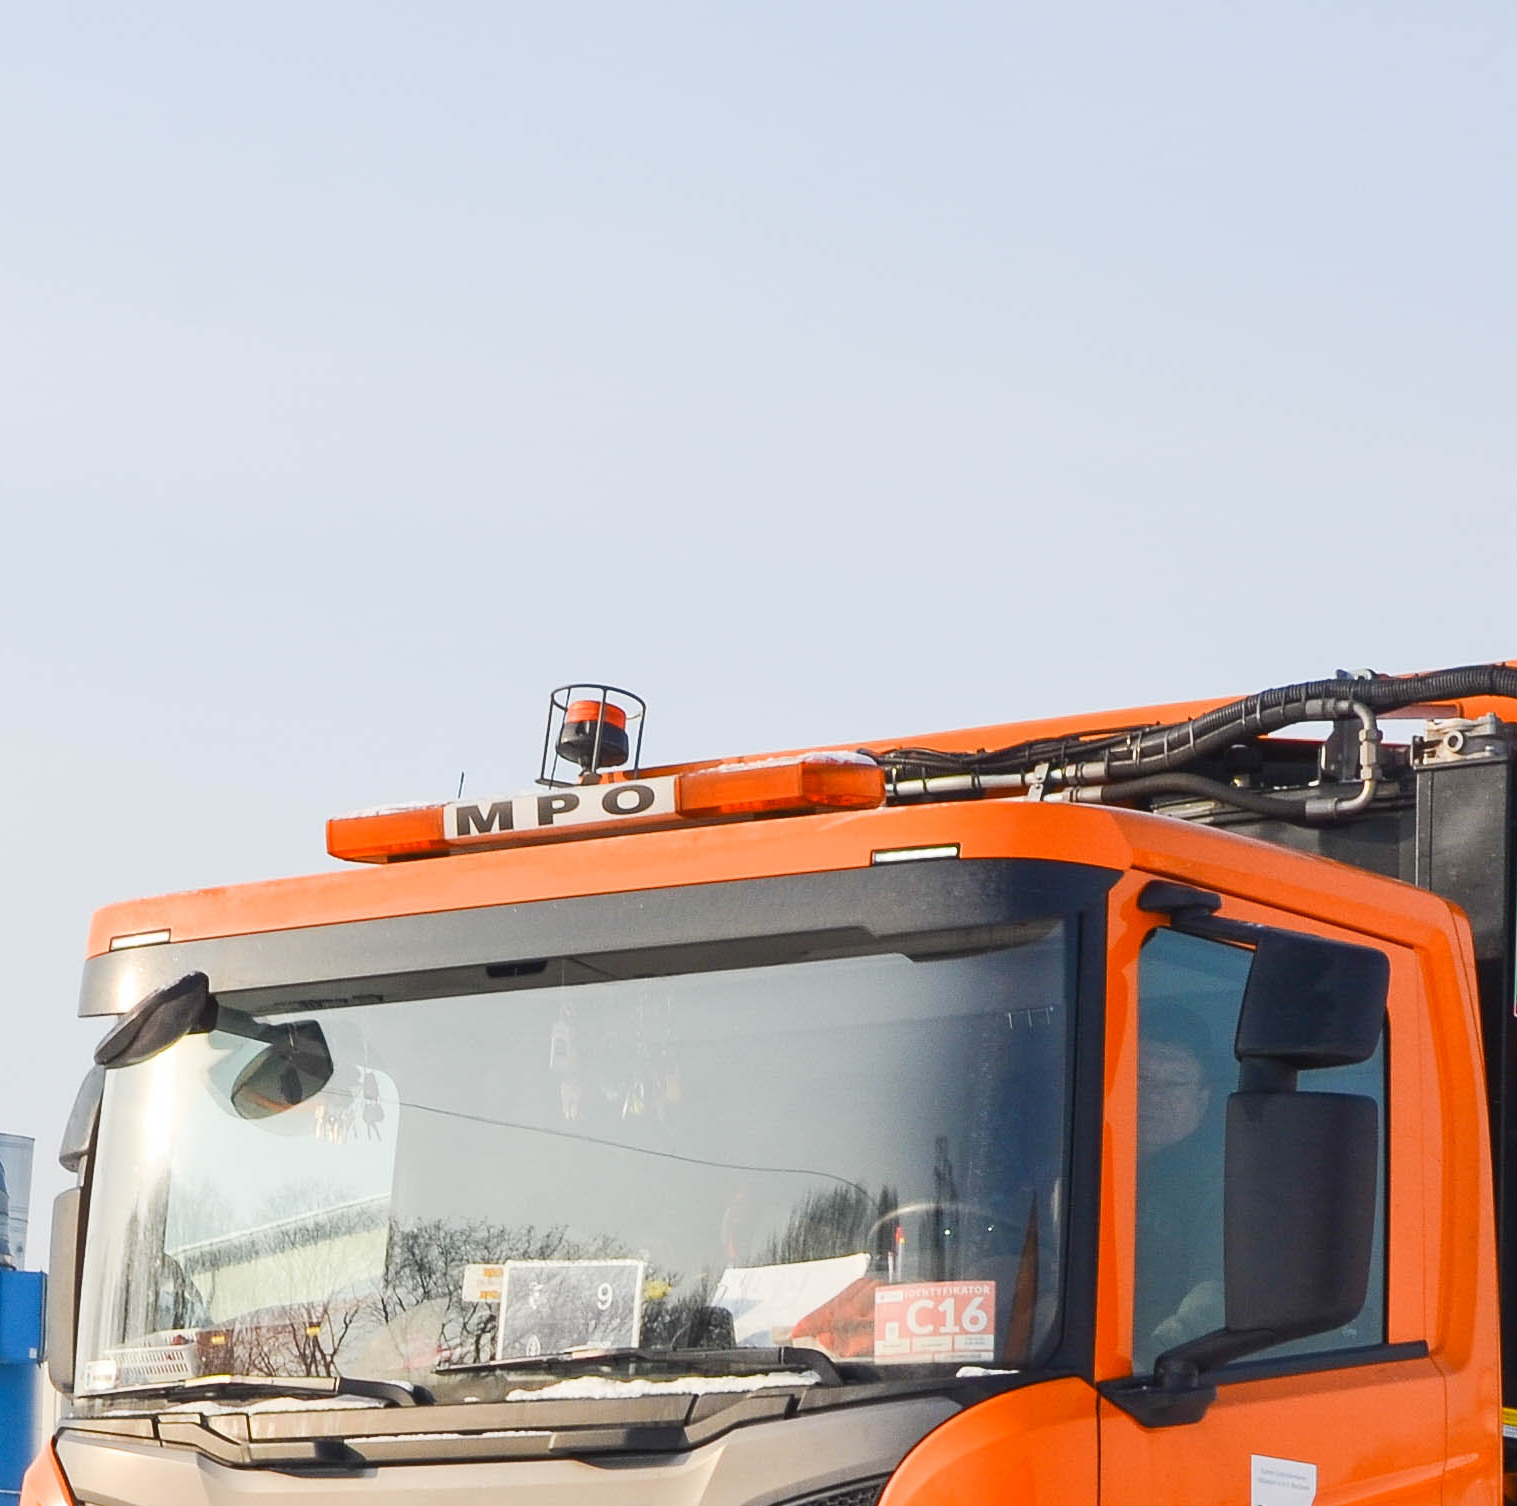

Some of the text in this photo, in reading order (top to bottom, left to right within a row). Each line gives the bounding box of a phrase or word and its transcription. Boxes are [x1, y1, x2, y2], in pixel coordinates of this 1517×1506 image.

[456, 784, 655, 836] MPO
[596, 1282, 613, 1310] 9
[906, 1297, 988, 1335] C16
